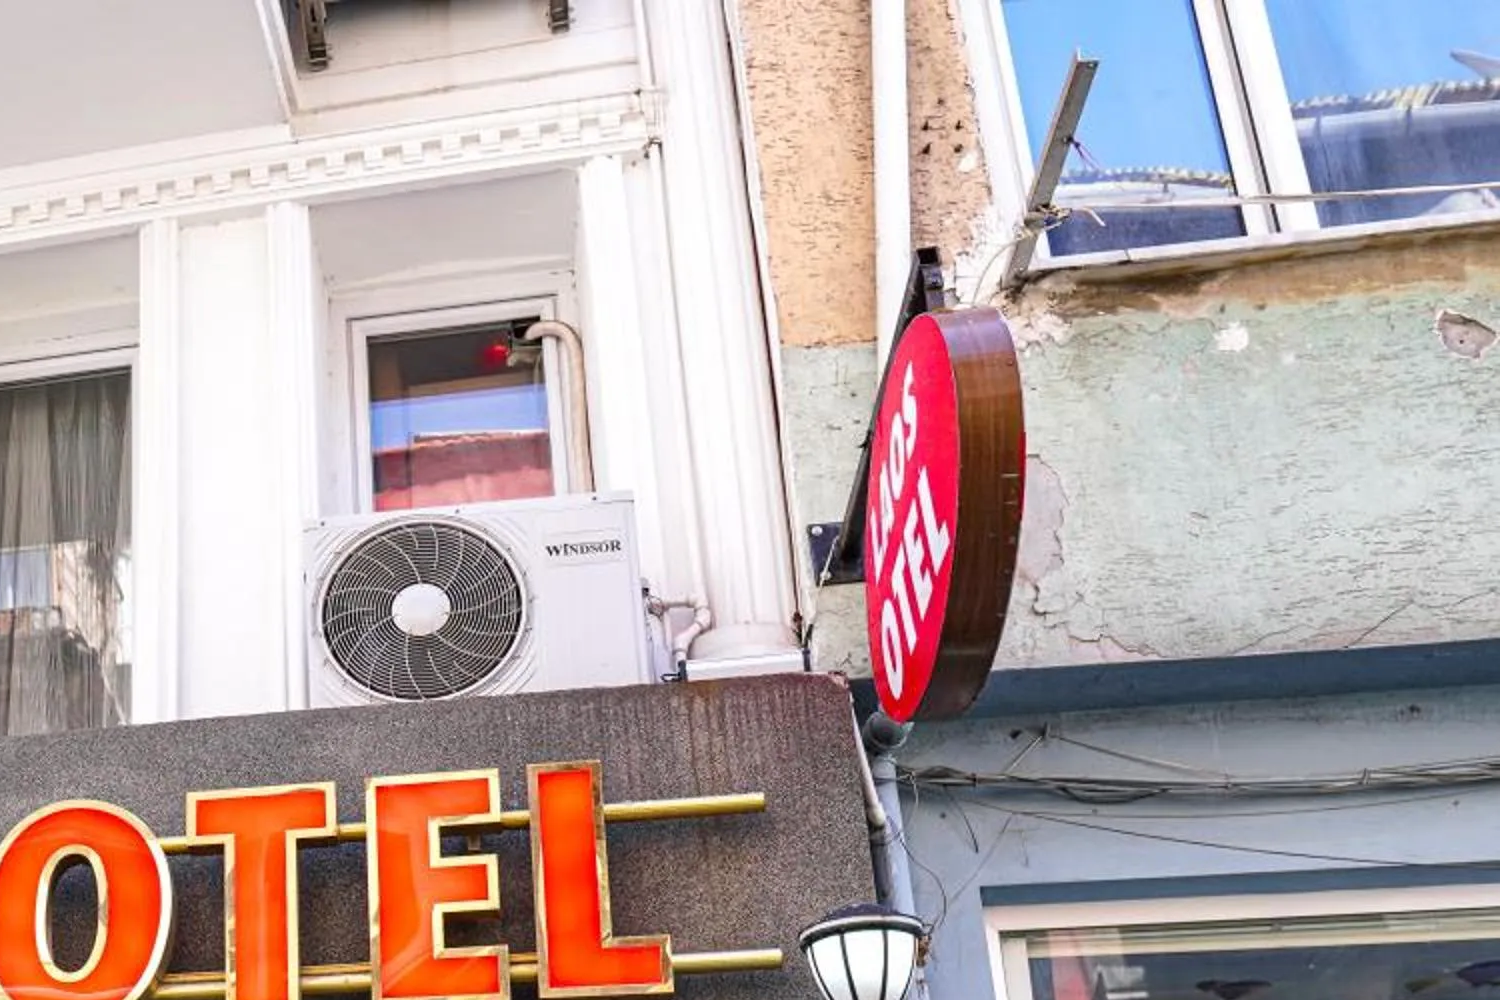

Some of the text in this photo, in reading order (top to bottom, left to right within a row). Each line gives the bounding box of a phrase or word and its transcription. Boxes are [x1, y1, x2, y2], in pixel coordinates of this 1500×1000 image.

[545, 540, 622, 557] WINDSOR
[869, 360, 917, 583] LAOS
[880, 466, 950, 700] OTEL
